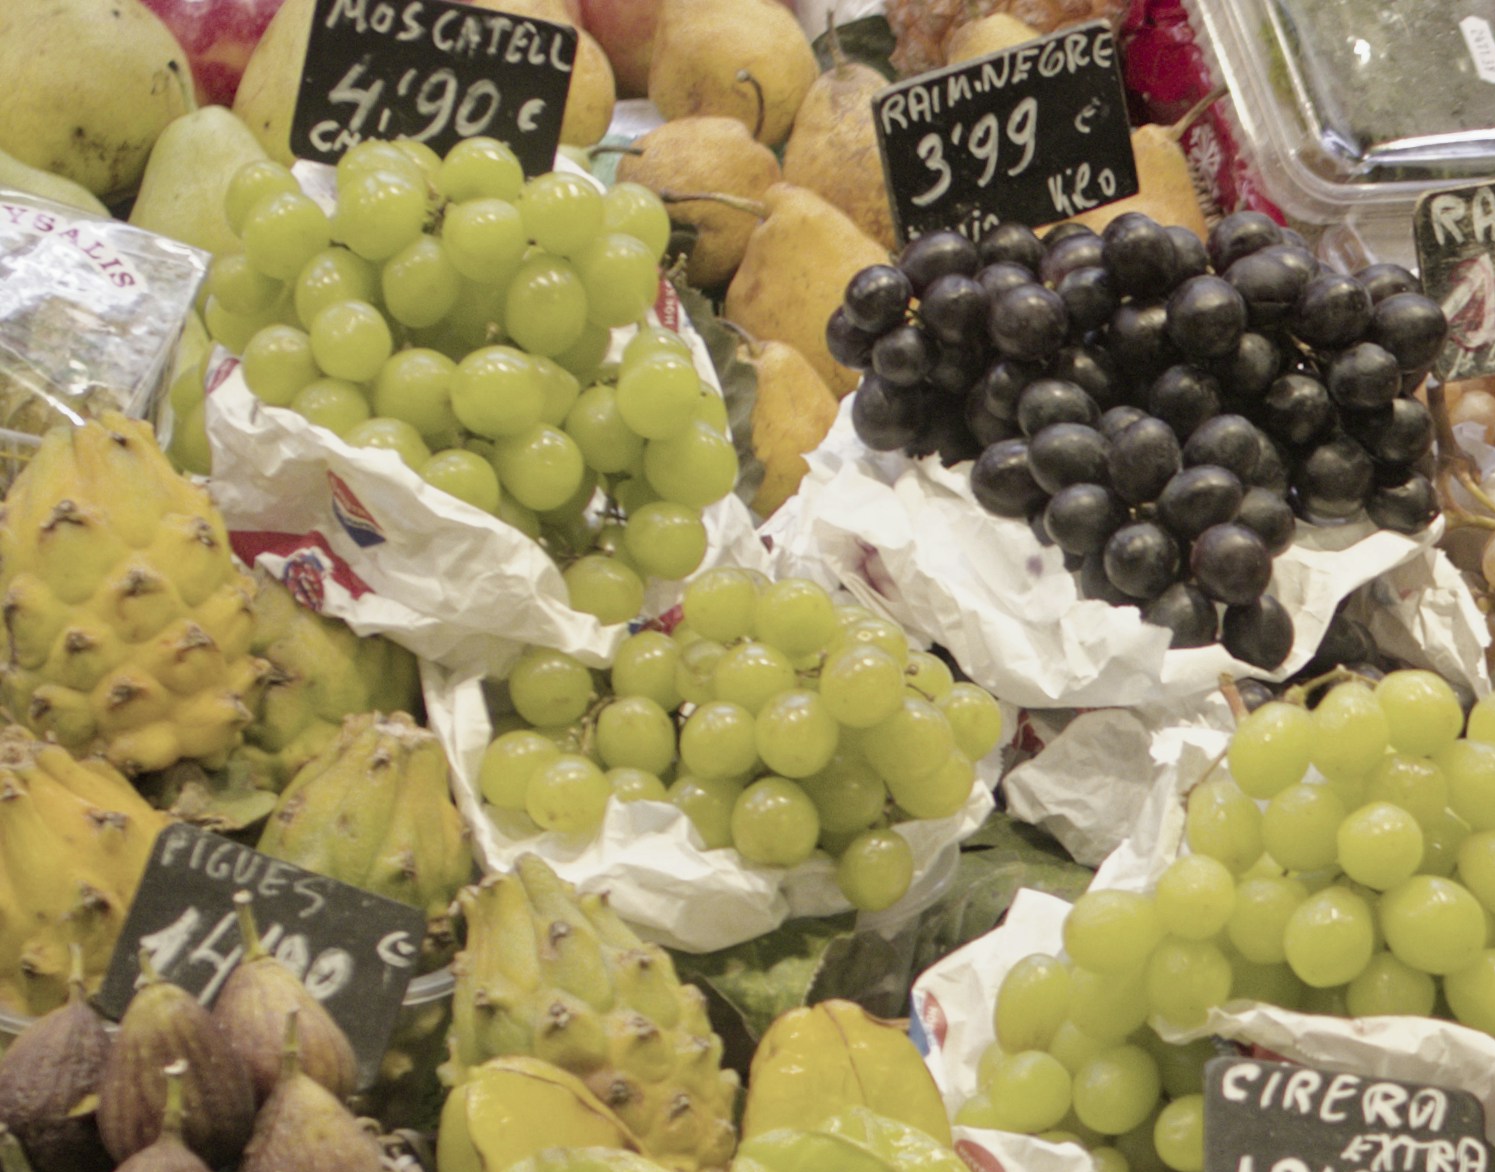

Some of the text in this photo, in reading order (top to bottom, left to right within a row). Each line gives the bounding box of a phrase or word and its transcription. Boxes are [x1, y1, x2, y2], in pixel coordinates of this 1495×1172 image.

[325, 0, 572, 73] MOSCATELL
[327, 62, 500, 143] 4'90
[910, 96, 1038, 207] 3'99
[1222, 1062, 1448, 1132] CIRERA
